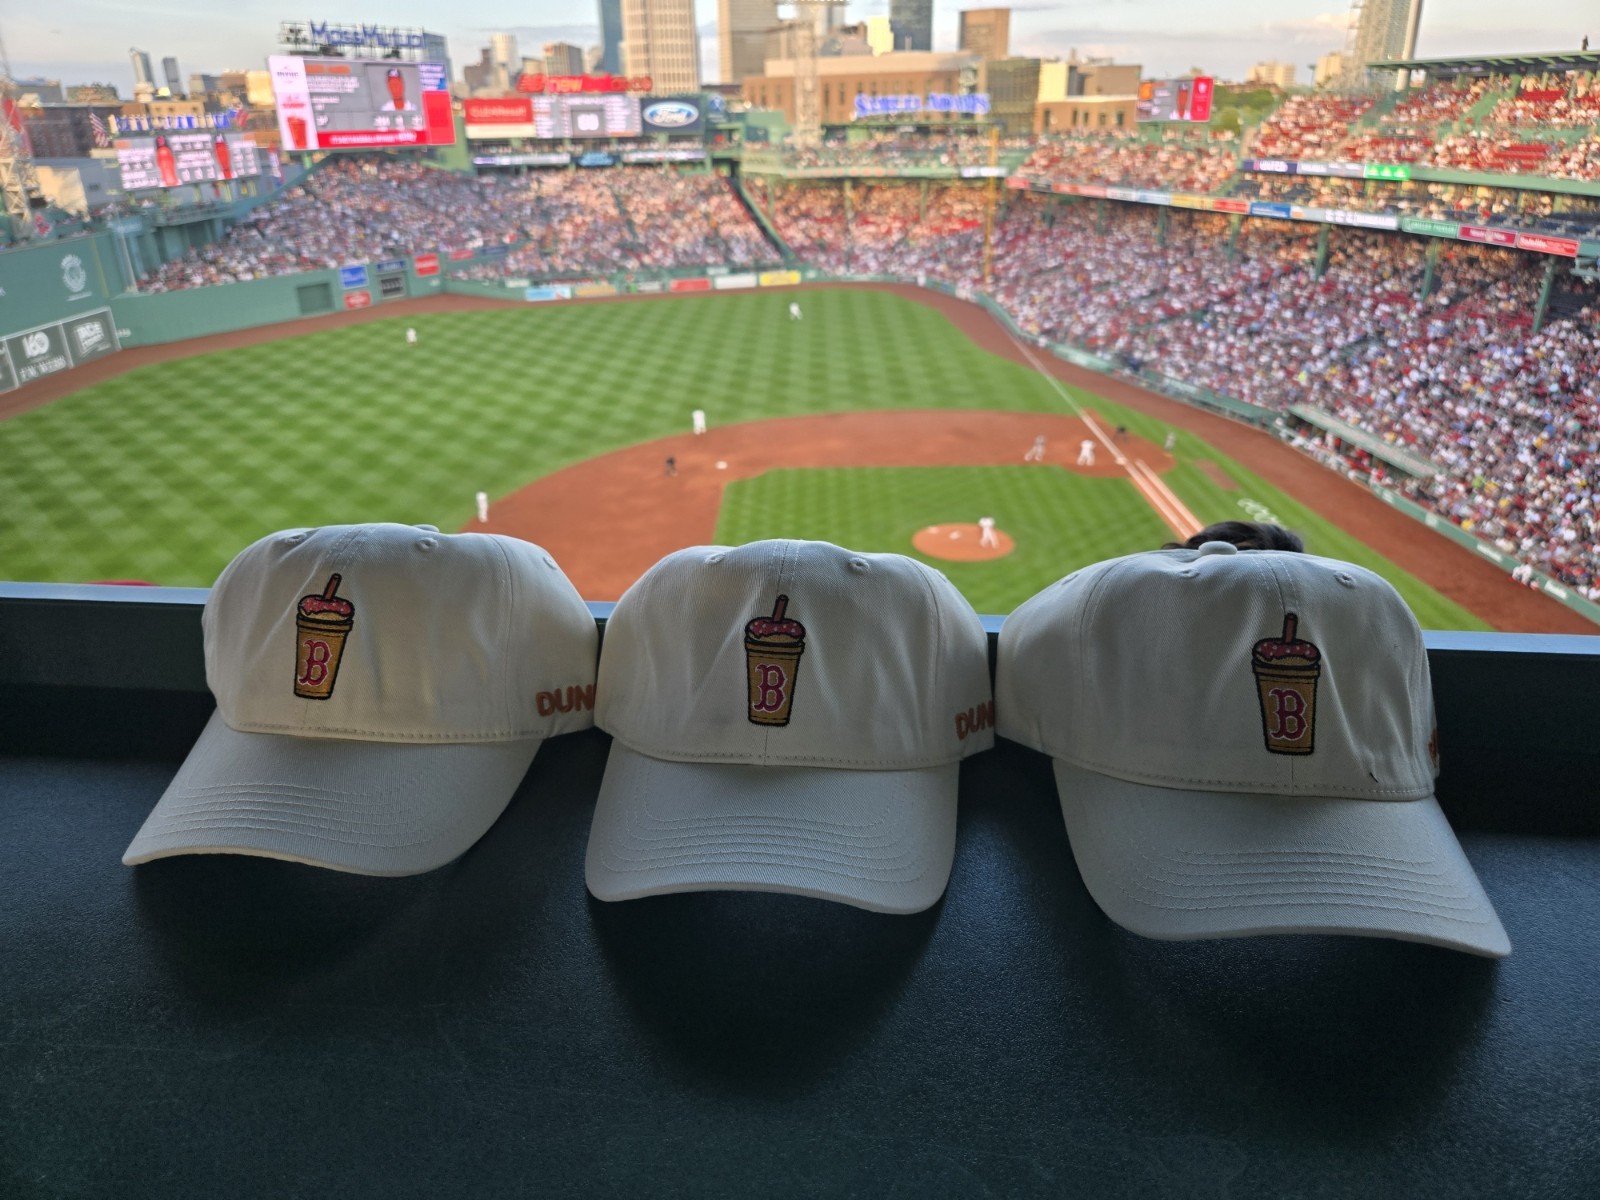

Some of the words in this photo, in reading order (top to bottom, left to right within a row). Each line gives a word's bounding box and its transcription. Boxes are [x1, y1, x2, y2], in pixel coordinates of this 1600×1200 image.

[298, 639, 332, 686] B
[752, 663, 788, 713] B
[1268, 687, 1308, 740] B
